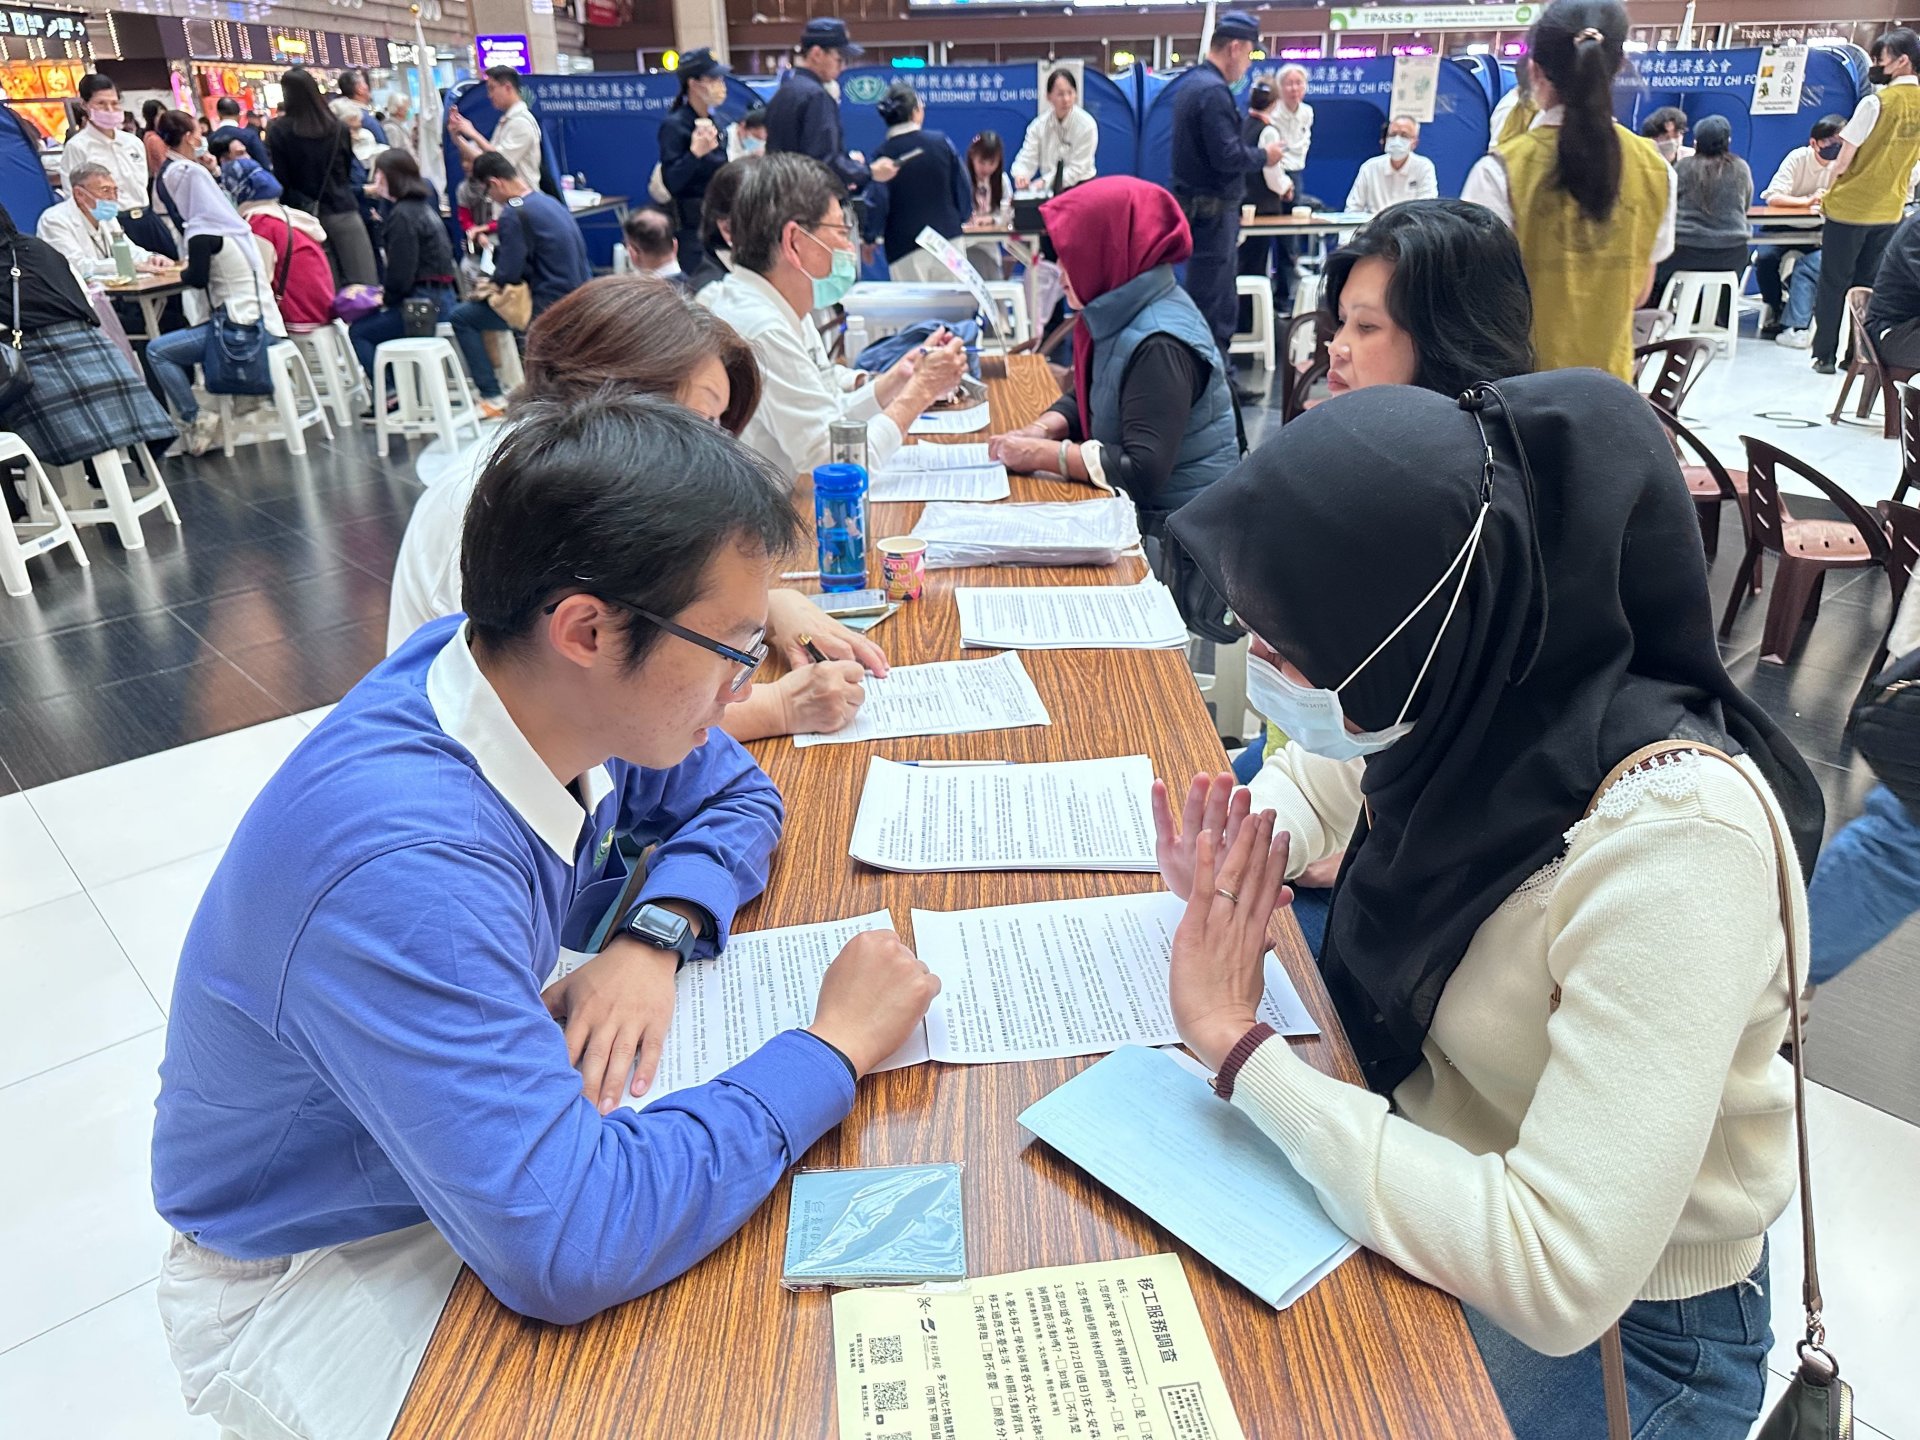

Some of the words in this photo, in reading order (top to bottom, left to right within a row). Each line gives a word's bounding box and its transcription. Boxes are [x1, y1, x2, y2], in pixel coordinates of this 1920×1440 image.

[1364, 13, 1403, 24] TPASS
[1651, 75, 1700, 87] BUDDHIST
[1703, 75, 1722, 87] TZU
[1724, 74, 1741, 86] CHI
[1338, 82, 1357, 94] TZU
[1358, 81, 1376, 94] CHI
[929, 90, 976, 102] BUDDHIST
[979, 90, 999, 101] TZU
[1000, 89, 1018, 101] CHI
[540, 101, 575, 112] TAIWAN
[575, 100, 622, 112] BUDDHIST
[625, 99, 643, 111] TZU
[644, 98, 662, 110] CHI
[1137, 1277, 1178, 1363] 移工服務調查
